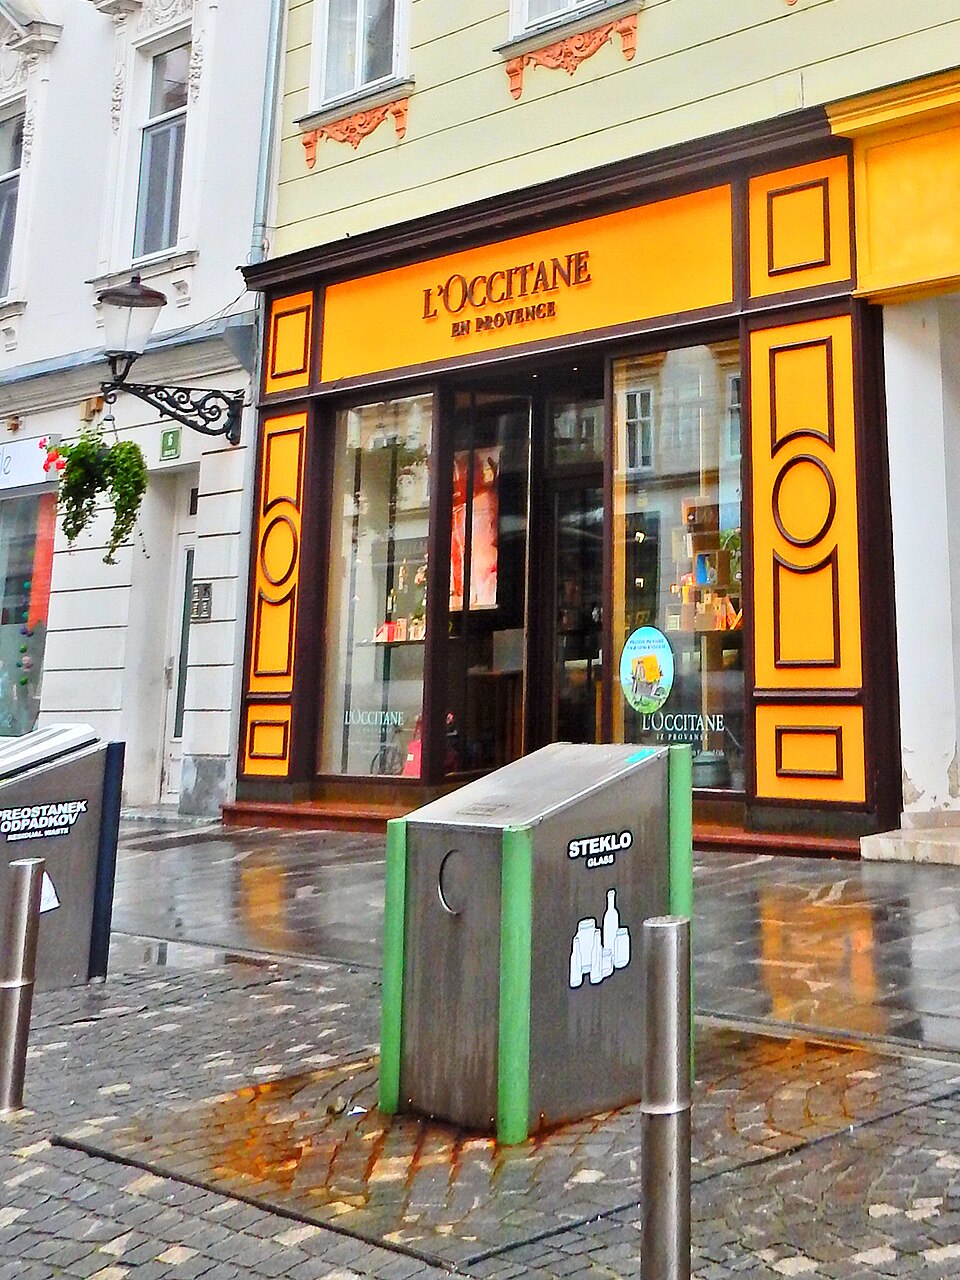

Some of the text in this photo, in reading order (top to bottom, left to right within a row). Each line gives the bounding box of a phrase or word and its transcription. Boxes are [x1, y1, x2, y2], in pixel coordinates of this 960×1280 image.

[421, 250, 593, 320] L'OCCITANE
[451, 301, 556, 338] EN PROVENCE
[344, 707, 404, 726] L'OCCITANE
[642, 711, 725, 731] L'OCCITANE
[0, 812, 79, 833] ODPADKOV
[569, 832, 632, 858] STEKLO
[587, 854, 614, 868] GLASS
